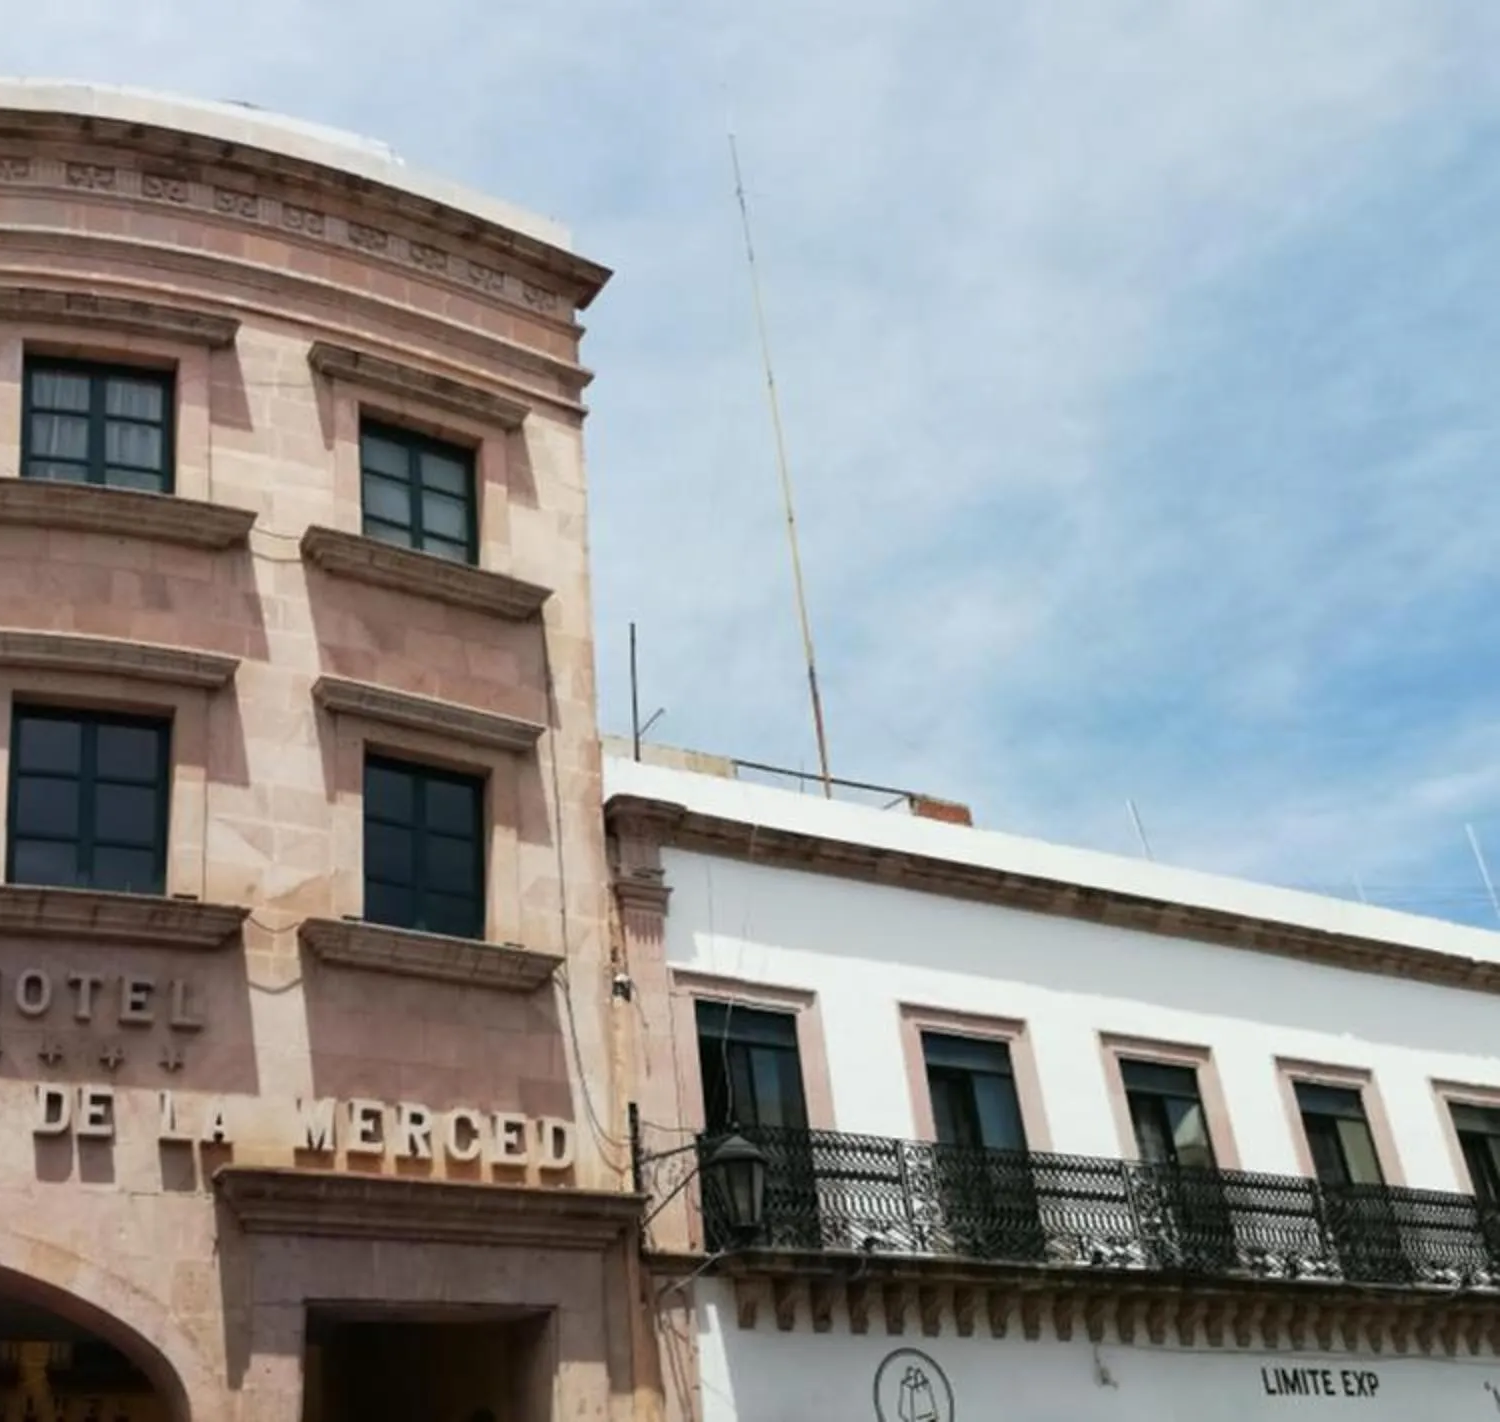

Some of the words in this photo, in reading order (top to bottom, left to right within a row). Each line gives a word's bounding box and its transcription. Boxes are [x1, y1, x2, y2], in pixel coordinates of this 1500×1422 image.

[33, 1082, 116, 1138] DE
[157, 1088, 234, 1145] LA
[295, 1097, 577, 1171] MERCED
[1261, 1366, 1336, 1397] LIMITE
[1340, 1369, 1380, 1398] EXP
